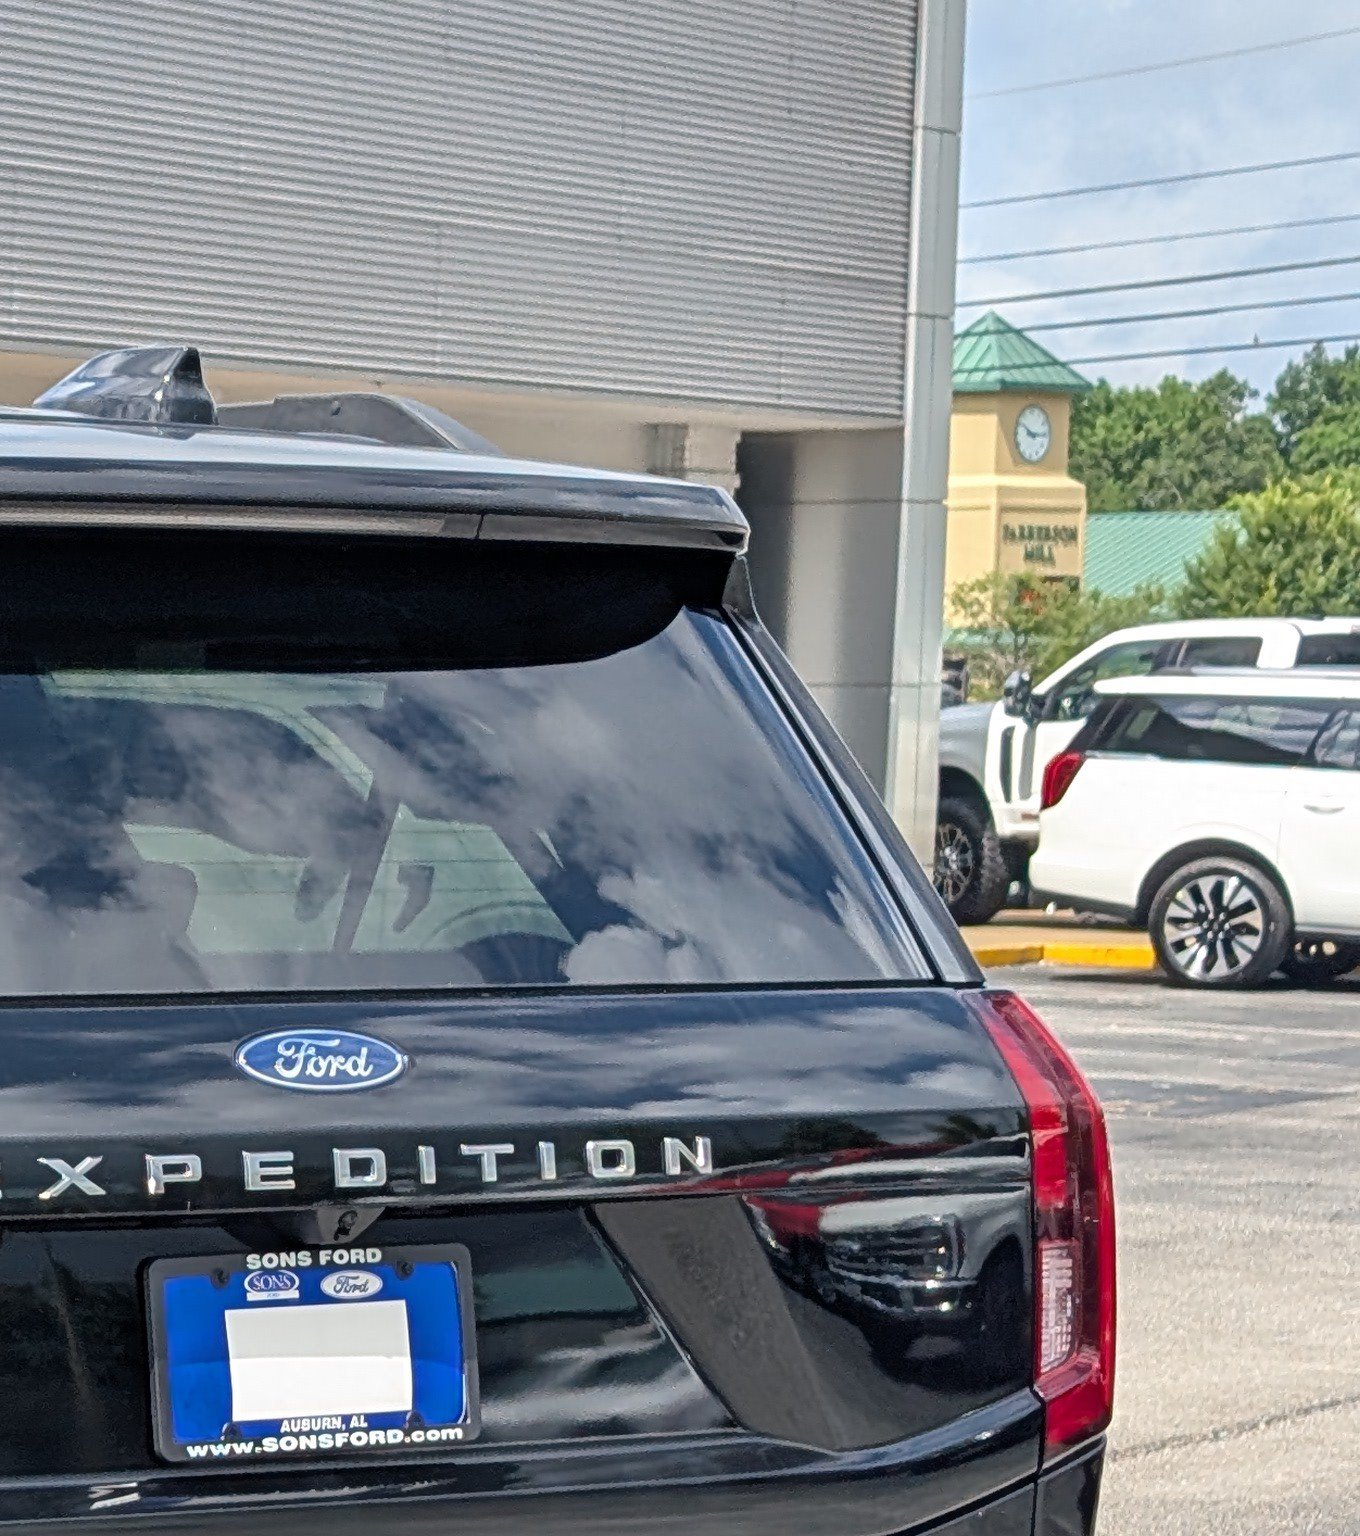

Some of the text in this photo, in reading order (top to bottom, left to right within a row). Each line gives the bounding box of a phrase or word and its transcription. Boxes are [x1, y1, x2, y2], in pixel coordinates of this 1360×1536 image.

[276, 1037, 373, 1079] Ford
[246, 1247, 383, 1270] SONS FORD
[253, 1275, 292, 1291] SONS
[333, 1275, 369, 1294] Ford
[280, 1414, 368, 1434] AUBURN, AL
[186, 1426, 464, 1458] www.SONSFORD.com
